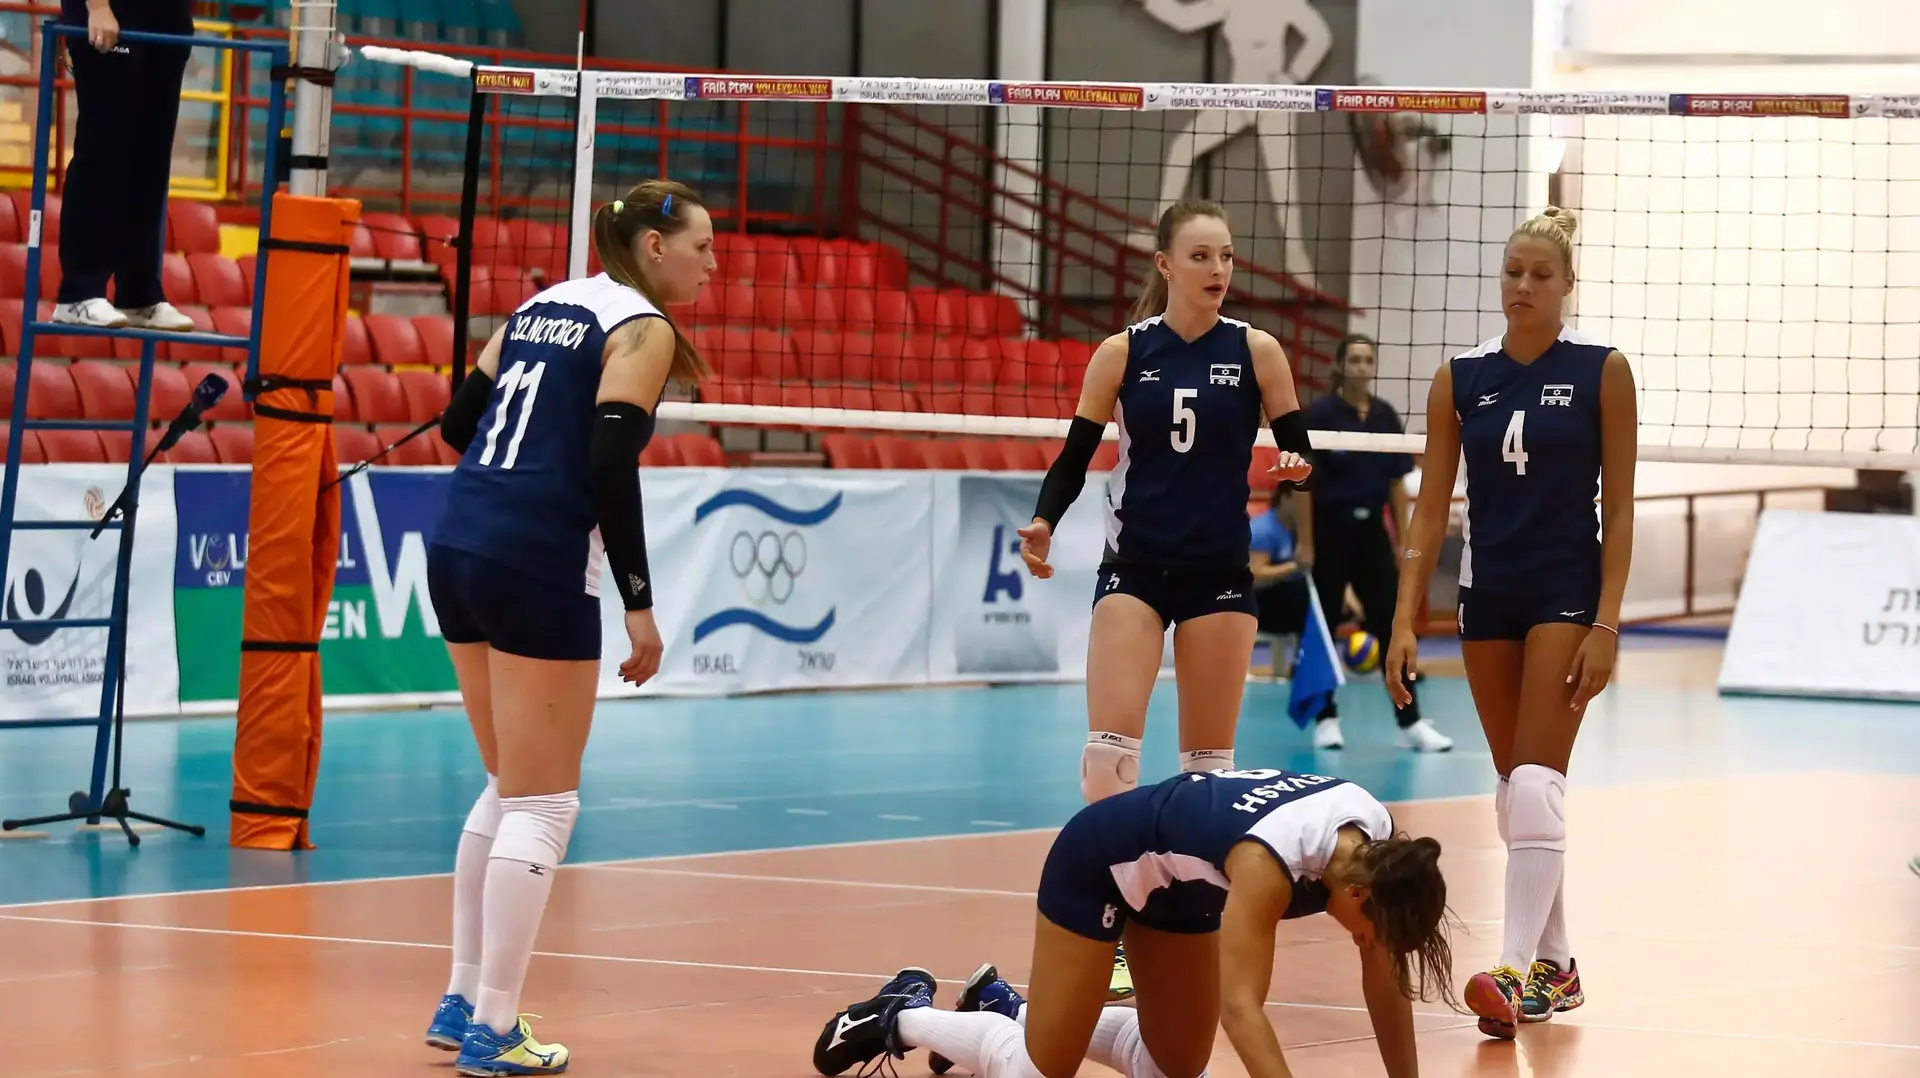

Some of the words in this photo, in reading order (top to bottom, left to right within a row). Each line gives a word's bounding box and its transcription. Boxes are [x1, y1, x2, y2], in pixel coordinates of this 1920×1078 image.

[477, 74, 511, 88] LEYBALL
[512, 75, 531, 88] WAY
[702, 81, 727, 94] FAIR
[728, 81, 754, 94] PLAY
[755, 82, 808, 95] VOLLEYBALL
[809, 83, 828, 95] WAY
[859, 91, 885, 99] ISRAEL
[887, 92, 933, 101] VOLLEYBALL
[936, 93, 987, 102] ASSOCIATION
[1007, 87, 1033, 99] FAIR
[1034, 88, 1061, 101] PLAY
[1063, 89, 1118, 103] VOLLEYBALL
[1118, 91, 1140, 105] WAY
[1336, 95, 1364, 107] FAIR
[1365, 96, 1395, 108] PLAY
[1397, 96, 1457, 110] VOLLEYBALL
[1458, 97, 1482, 110] WAY
[1171, 98, 1200, 107] ISRAEL
[1202, 98, 1254, 108] VOLLEYBALL
[1257, 100, 1312, 110] ASSOCIATION
[1518, 105, 1548, 114] ISRAEL
[1550, 105, 1606, 115] VOLLEYBALL
[1209, 379, 1240, 387] ISR
[479, 360, 547, 469] 11
[1170, 388, 1198, 453] 5
[1502, 410, 1529, 475] 4
[208, 571, 231, 586] CEV
[321, 600, 367, 640] EN
[1457, 603, 1465, 634] 4
[693, 653, 738, 675] ISRAEL
[7, 674, 36, 685] ISRAEL
